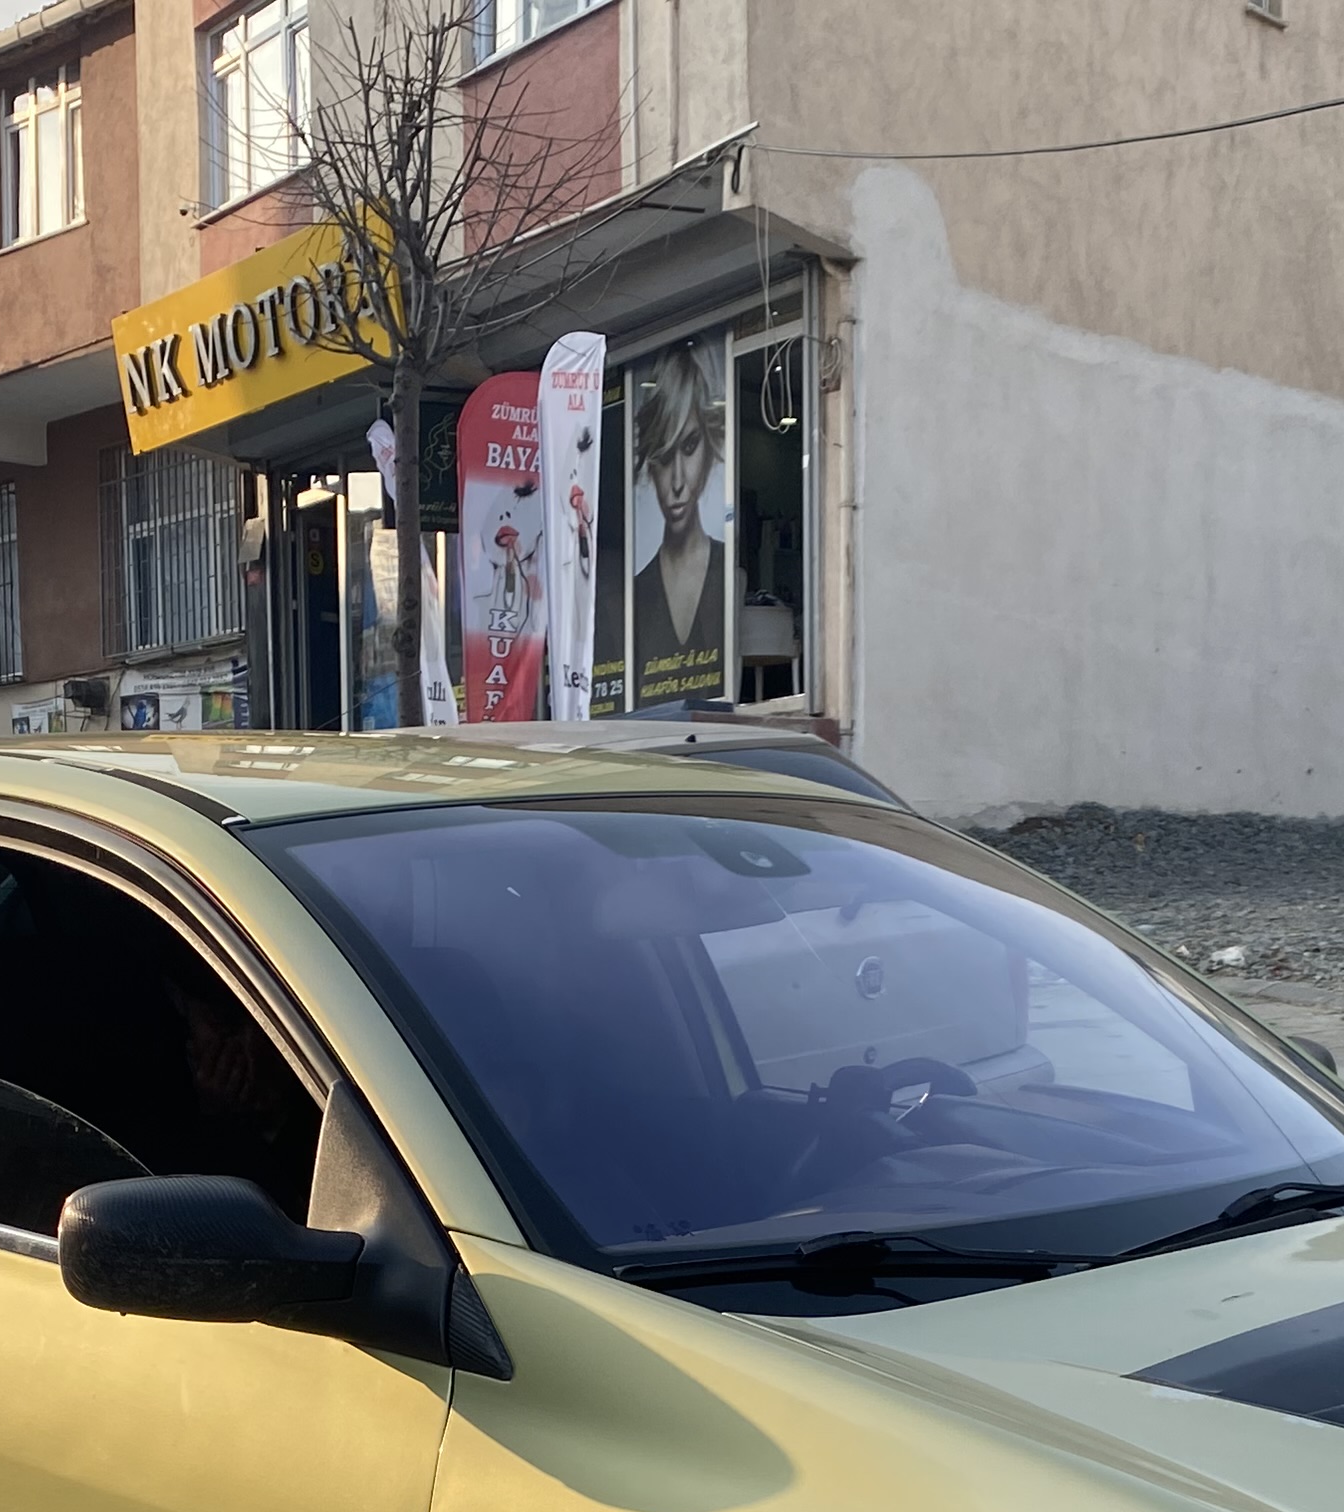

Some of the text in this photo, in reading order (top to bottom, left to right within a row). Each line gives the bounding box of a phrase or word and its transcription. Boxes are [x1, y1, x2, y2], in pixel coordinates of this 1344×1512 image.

[122, 333, 184, 415] NK
[567, 393, 586, 411] ALA
[486, 442, 541, 473] BAYA
[609, 679, 624, 696] 25
